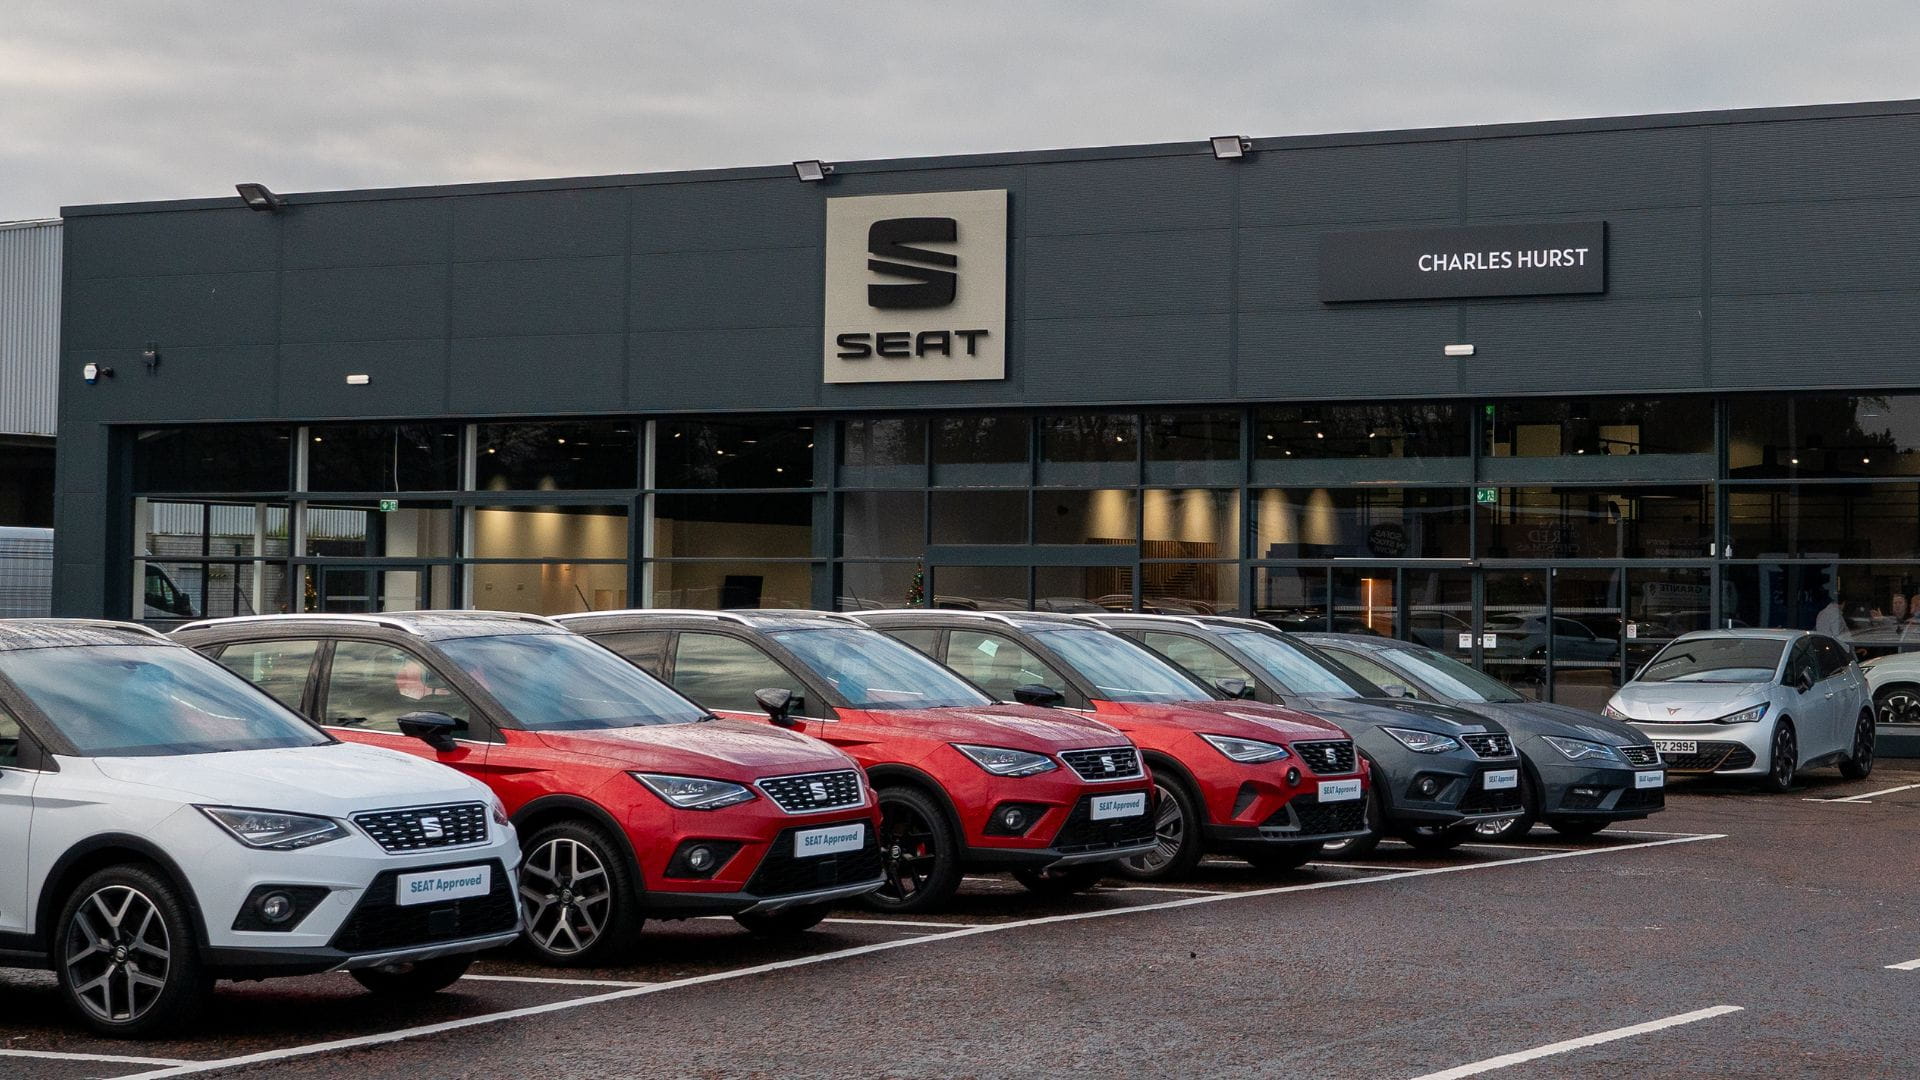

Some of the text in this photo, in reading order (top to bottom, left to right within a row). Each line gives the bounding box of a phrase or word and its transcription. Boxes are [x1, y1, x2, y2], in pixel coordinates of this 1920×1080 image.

[1418, 248, 1589, 272] CHARLES HURST
[836, 329, 989, 358] SEAT
[1670, 742, 1695, 752] 2995
[1323, 785, 1357, 795] SEAT Approved
[1099, 799, 1140, 811] SEAT Approved
[805, 831, 858, 846] SEAT Approved
[410, 873, 482, 893] SEAT Approved
